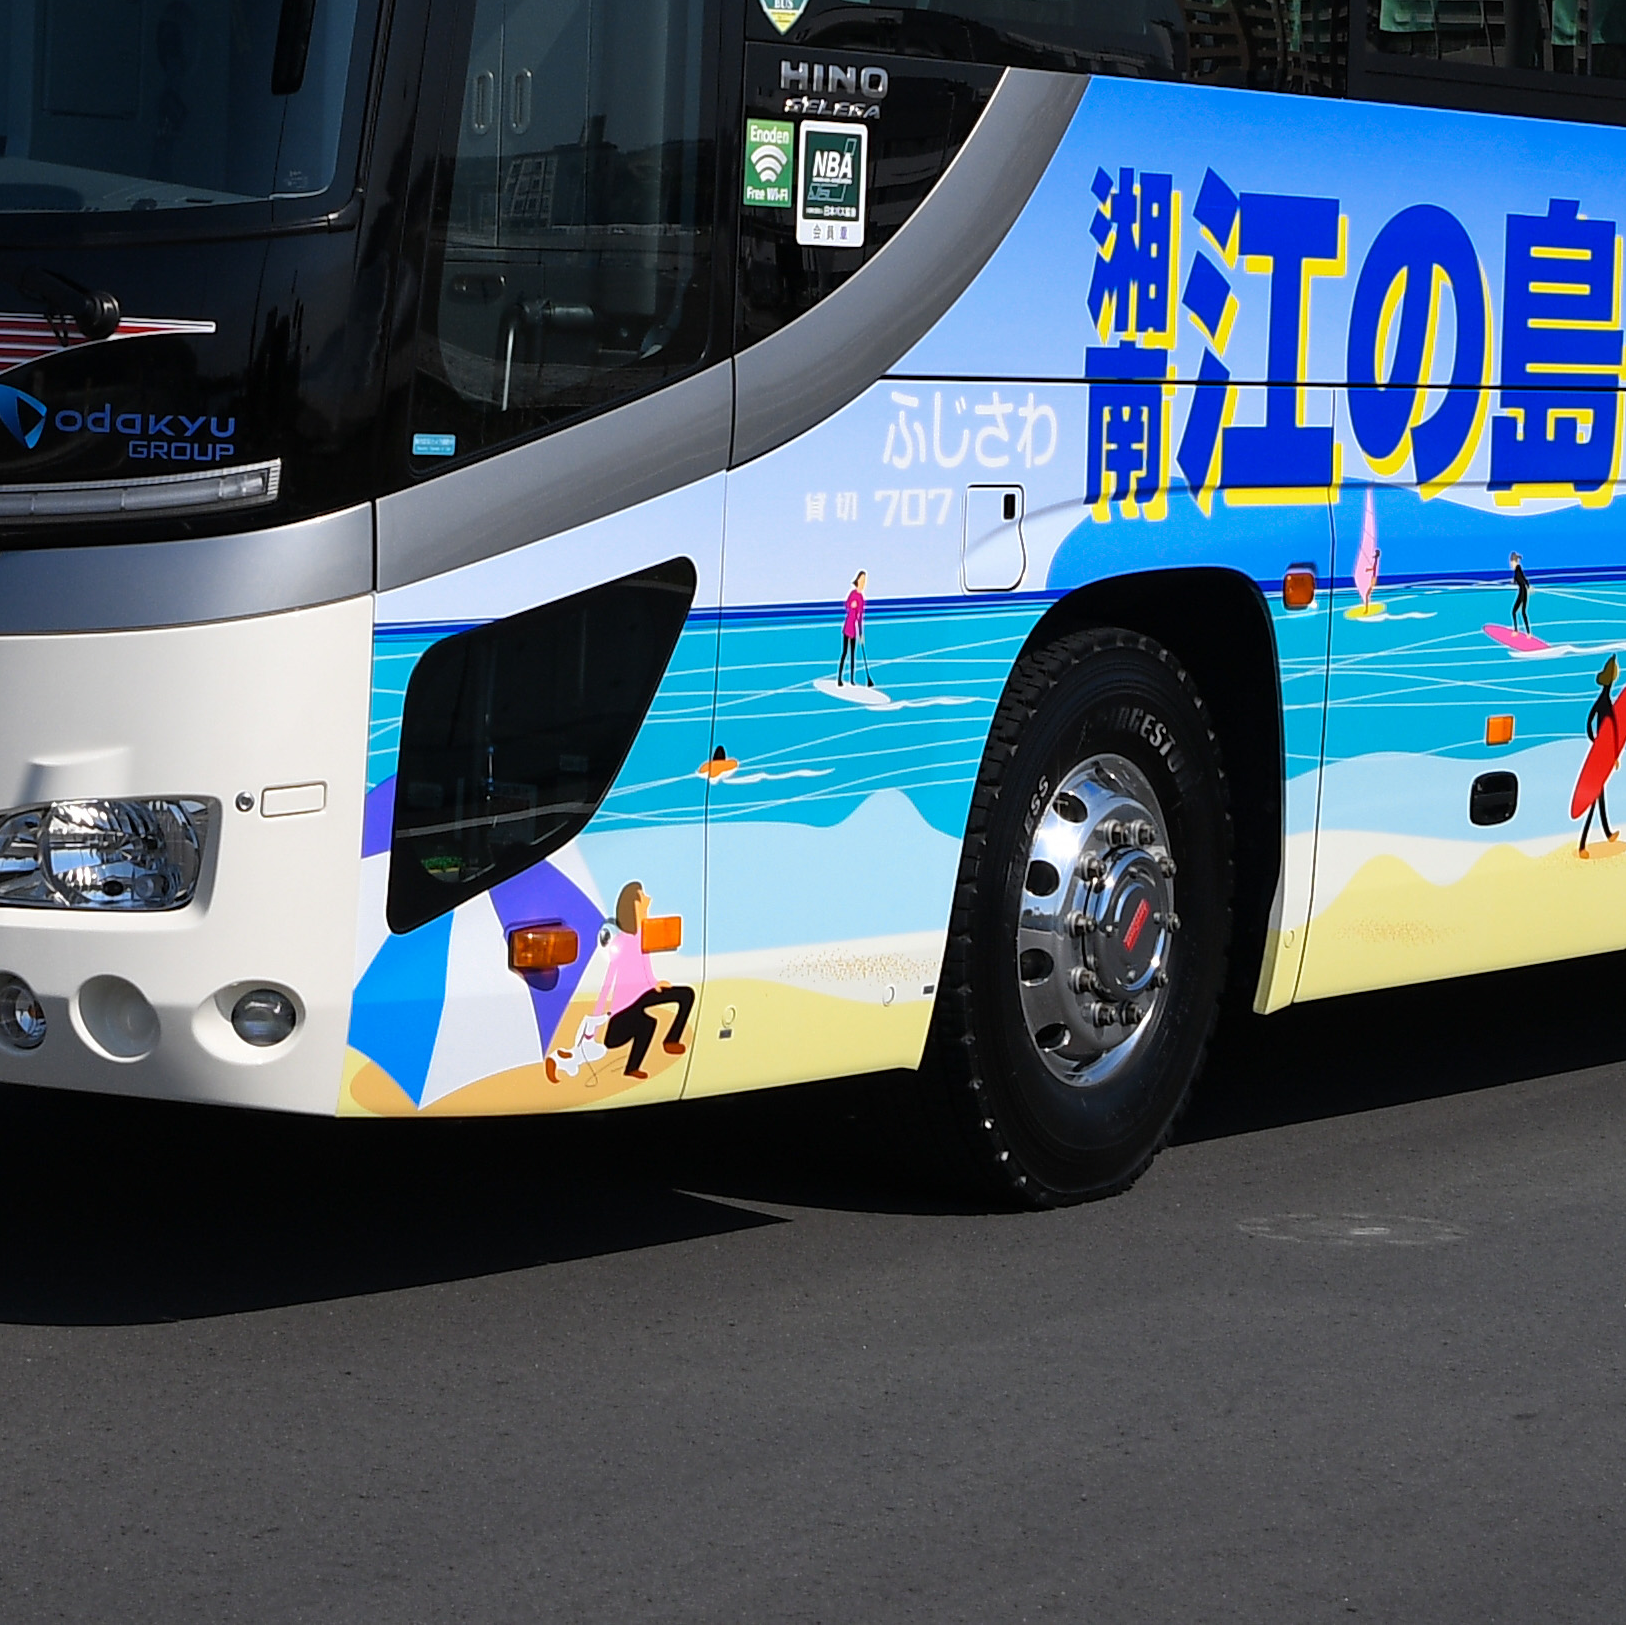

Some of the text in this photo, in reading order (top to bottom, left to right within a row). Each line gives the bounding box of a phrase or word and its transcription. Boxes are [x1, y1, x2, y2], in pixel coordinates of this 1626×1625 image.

[780, 60, 889, 99] HINO
[784, 96, 881, 120] SELEGA
[750, 125, 790, 144] Enoden
[812, 150, 853, 179] NBA
[746, 186, 789, 202] Free Wi-Fi
[1084, 165, 1181, 522] 湘南
[882, 390, 1058, 470] ふじさわ
[128, 439, 235, 462] GROUP
[874, 488, 954, 527] 707
